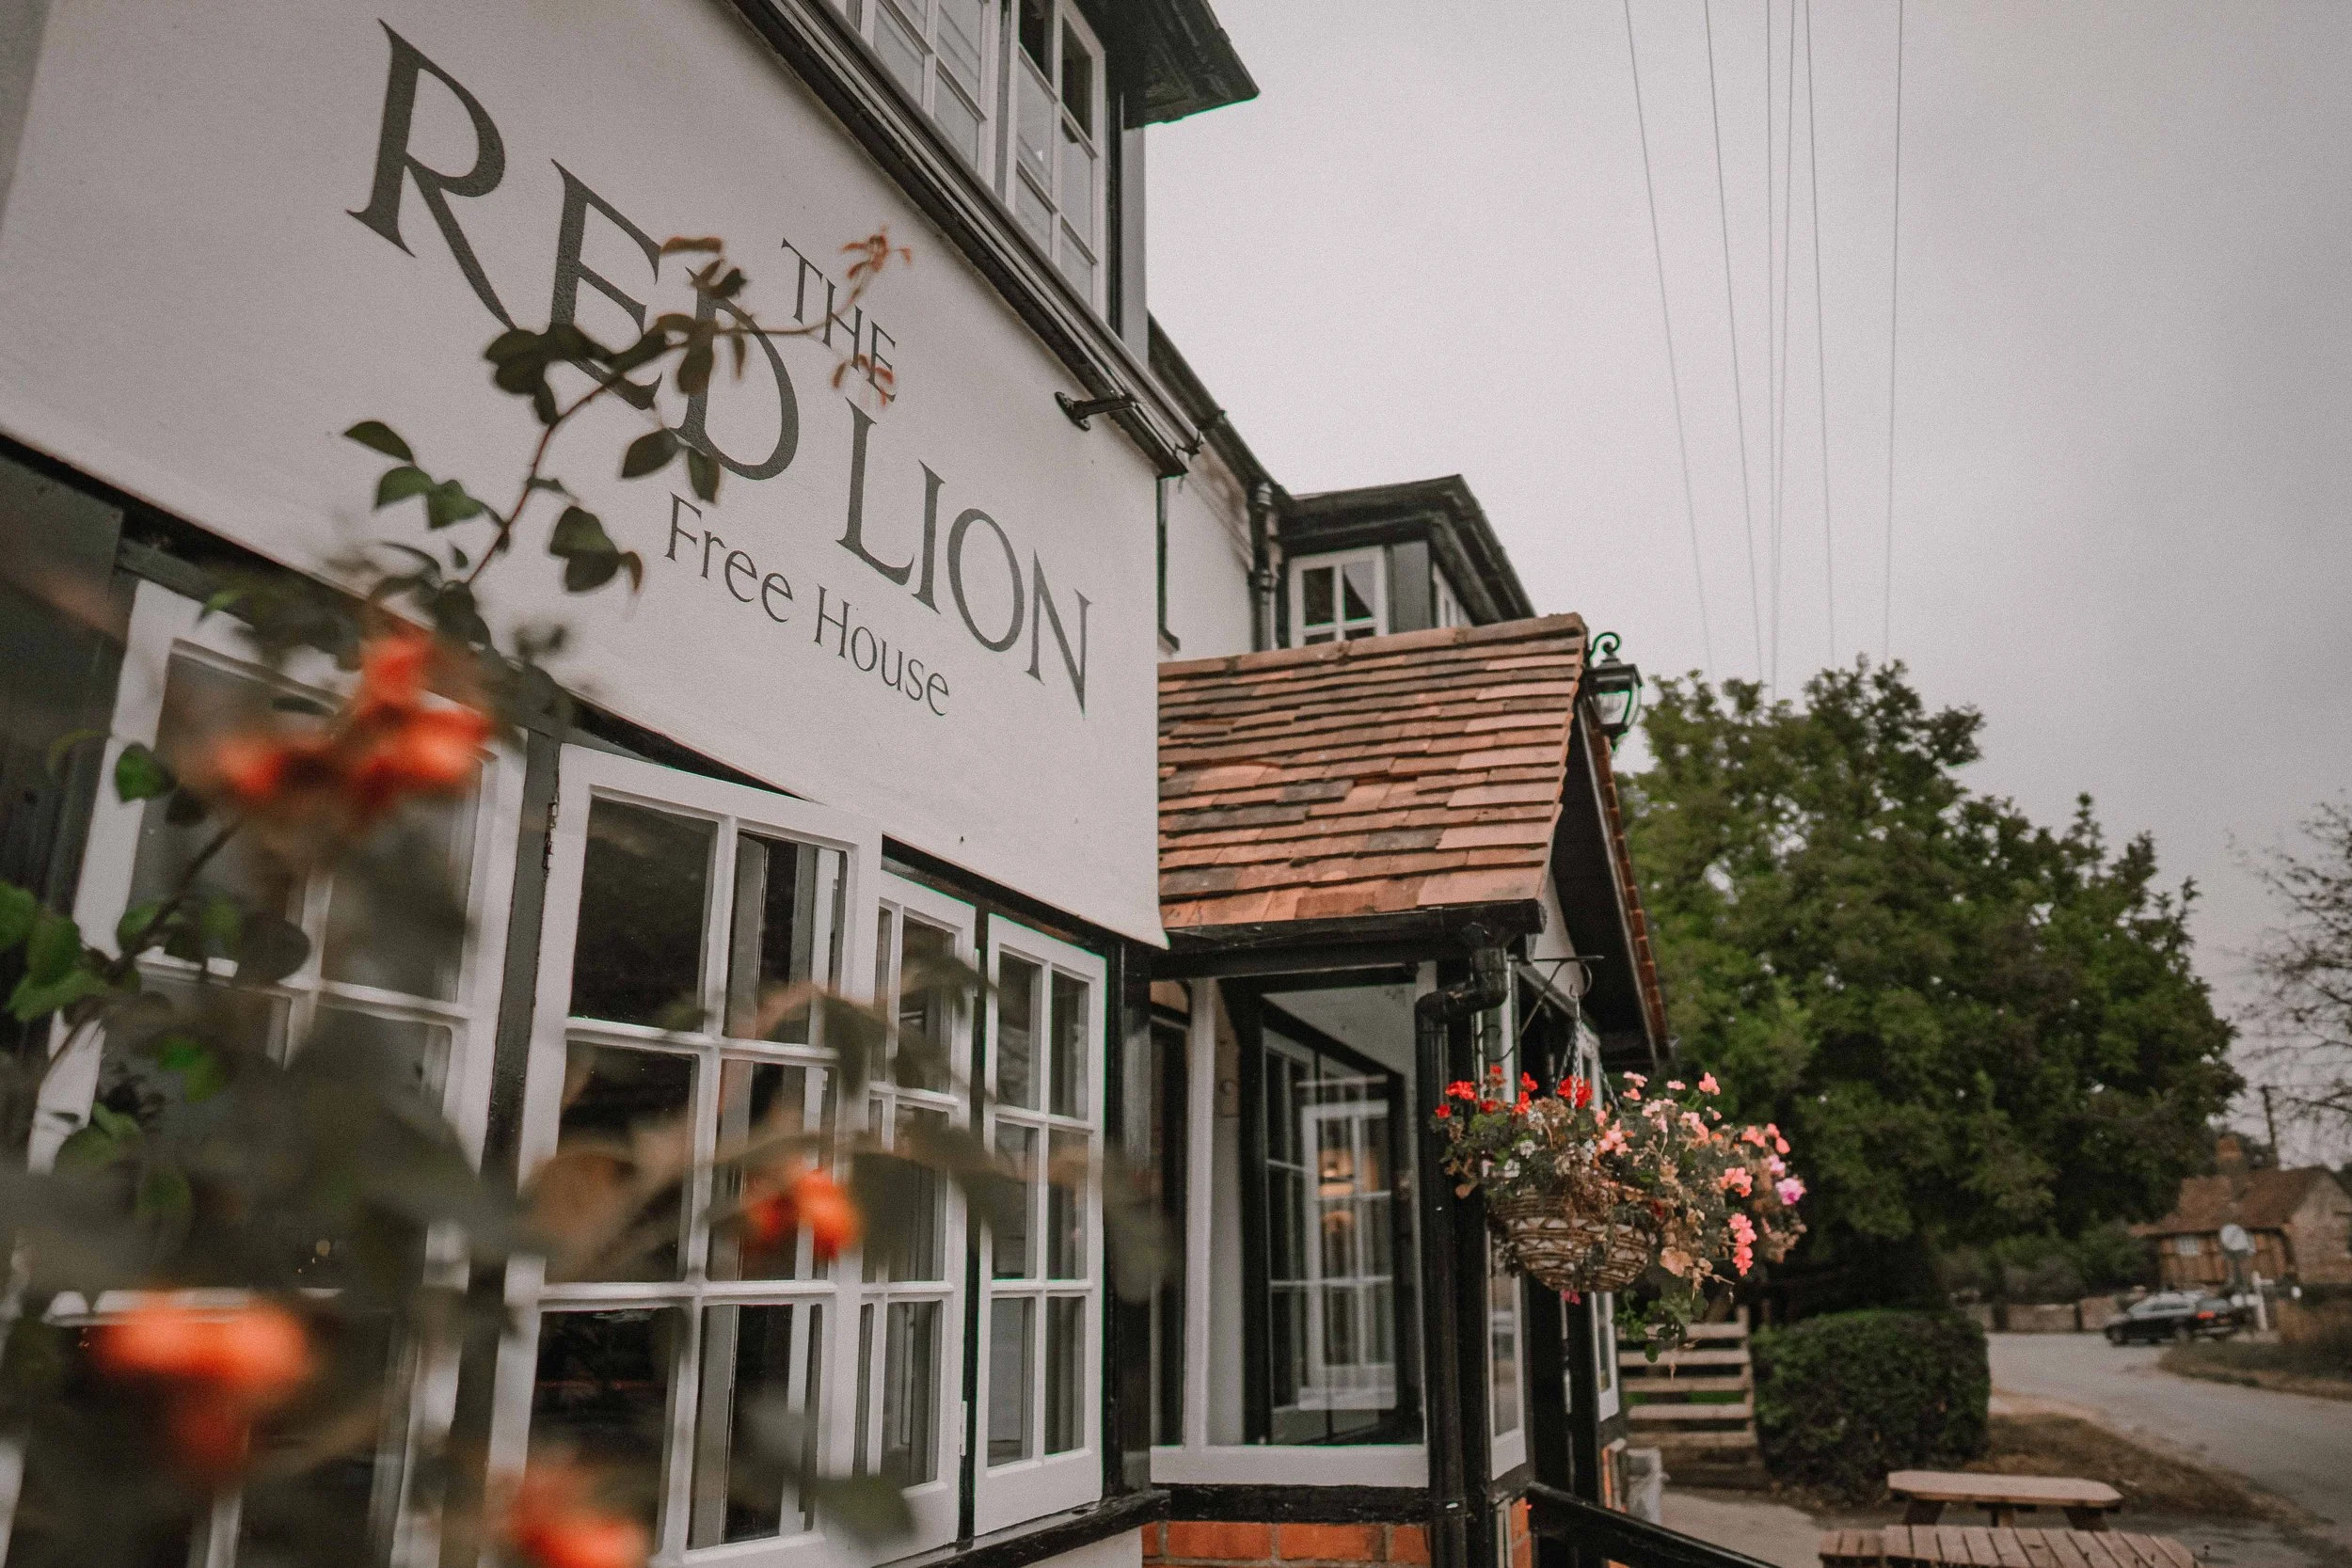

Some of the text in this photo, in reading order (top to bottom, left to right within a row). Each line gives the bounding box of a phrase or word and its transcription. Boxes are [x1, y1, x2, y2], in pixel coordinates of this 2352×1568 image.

[345, 18, 1093, 721] RED LION
[781, 238, 897, 403] THE
[664, 491, 950, 717] Free House
